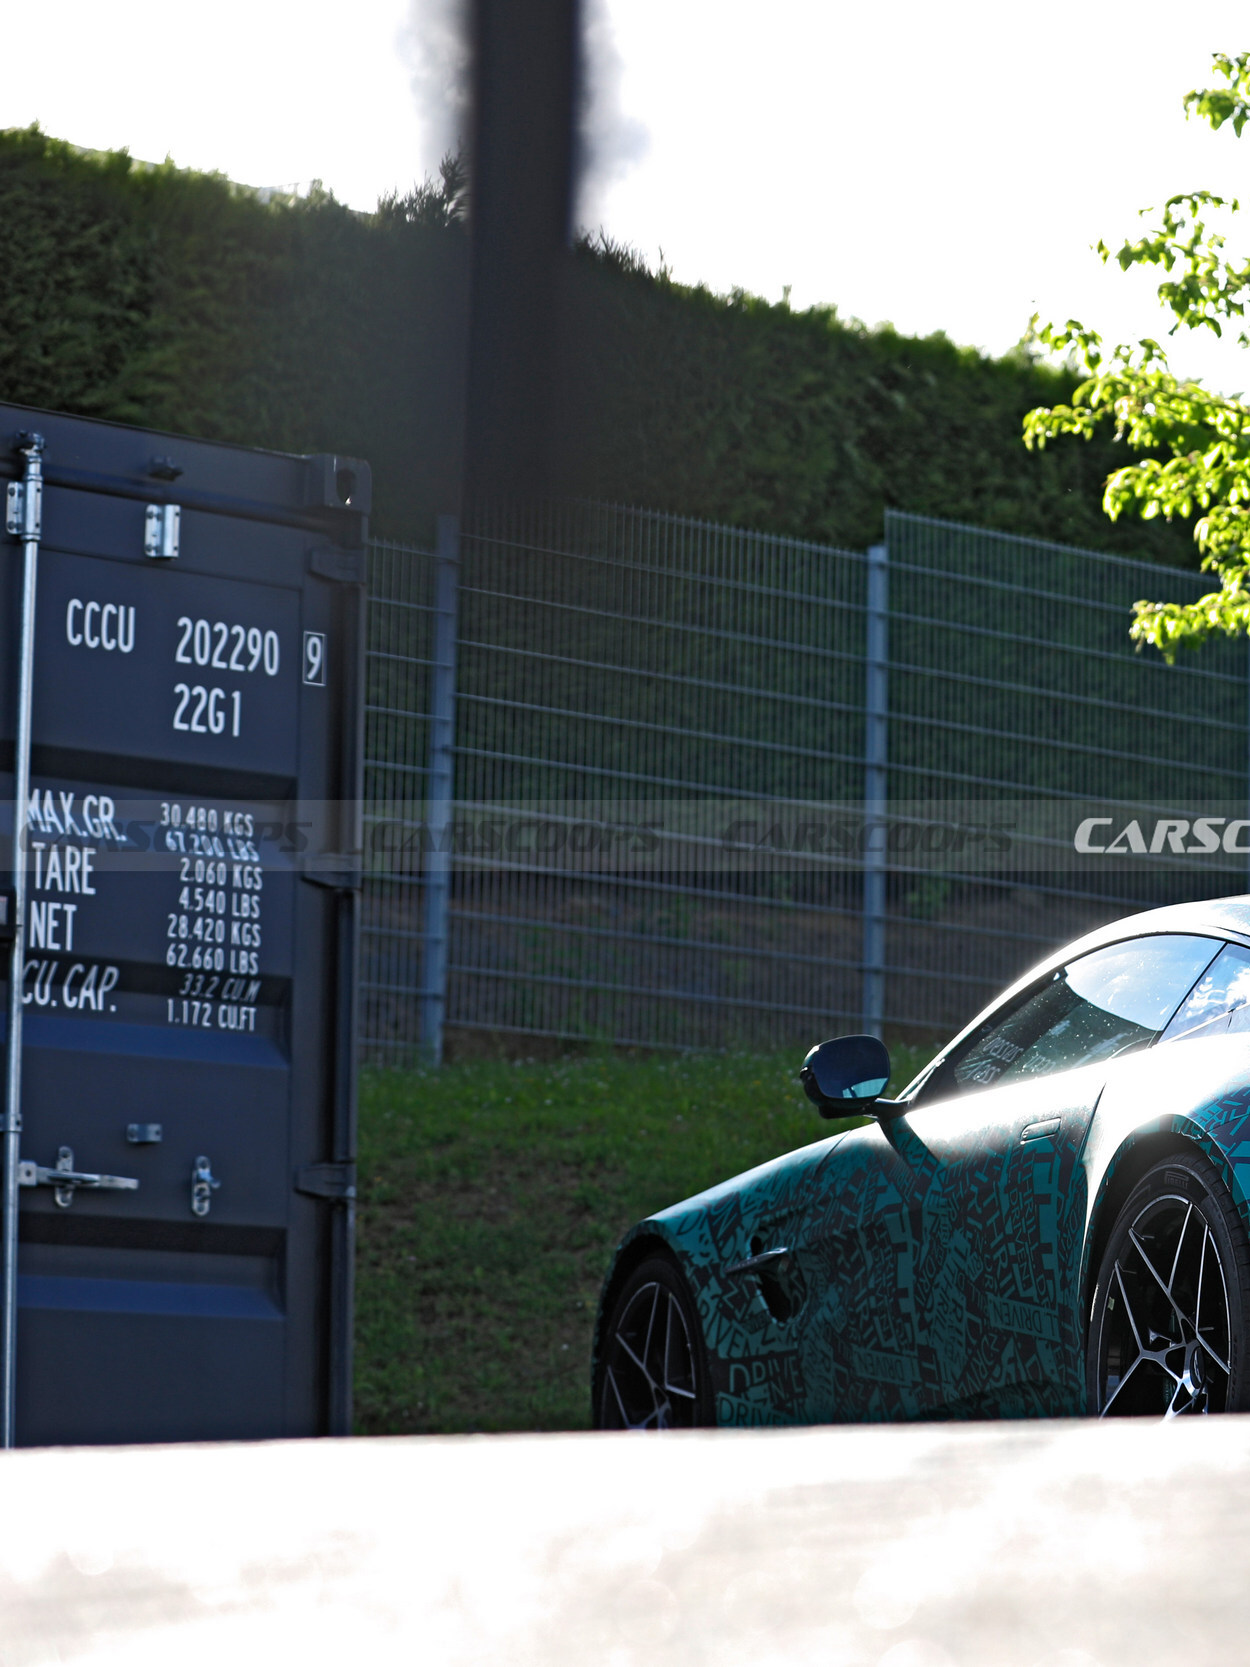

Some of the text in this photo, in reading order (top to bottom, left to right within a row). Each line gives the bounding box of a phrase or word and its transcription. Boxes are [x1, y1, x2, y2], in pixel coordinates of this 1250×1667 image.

[66, 599, 323, 680] CCCU 202290 9
[173, 683, 241, 737] 22G1
[160, 802, 218, 832] 30.480
[223, 811, 254, 837] KGS
[31, 841, 263, 895] TARE 2.060 KGS
[227, 838, 260, 863] LBS
[179, 886, 261, 919] 4.540 LBS
[30, 900, 261, 951] NET 28.420 KGS
[166, 943, 259, 976] 62.660 LBS
[168, 998, 212, 1027] 1.172
